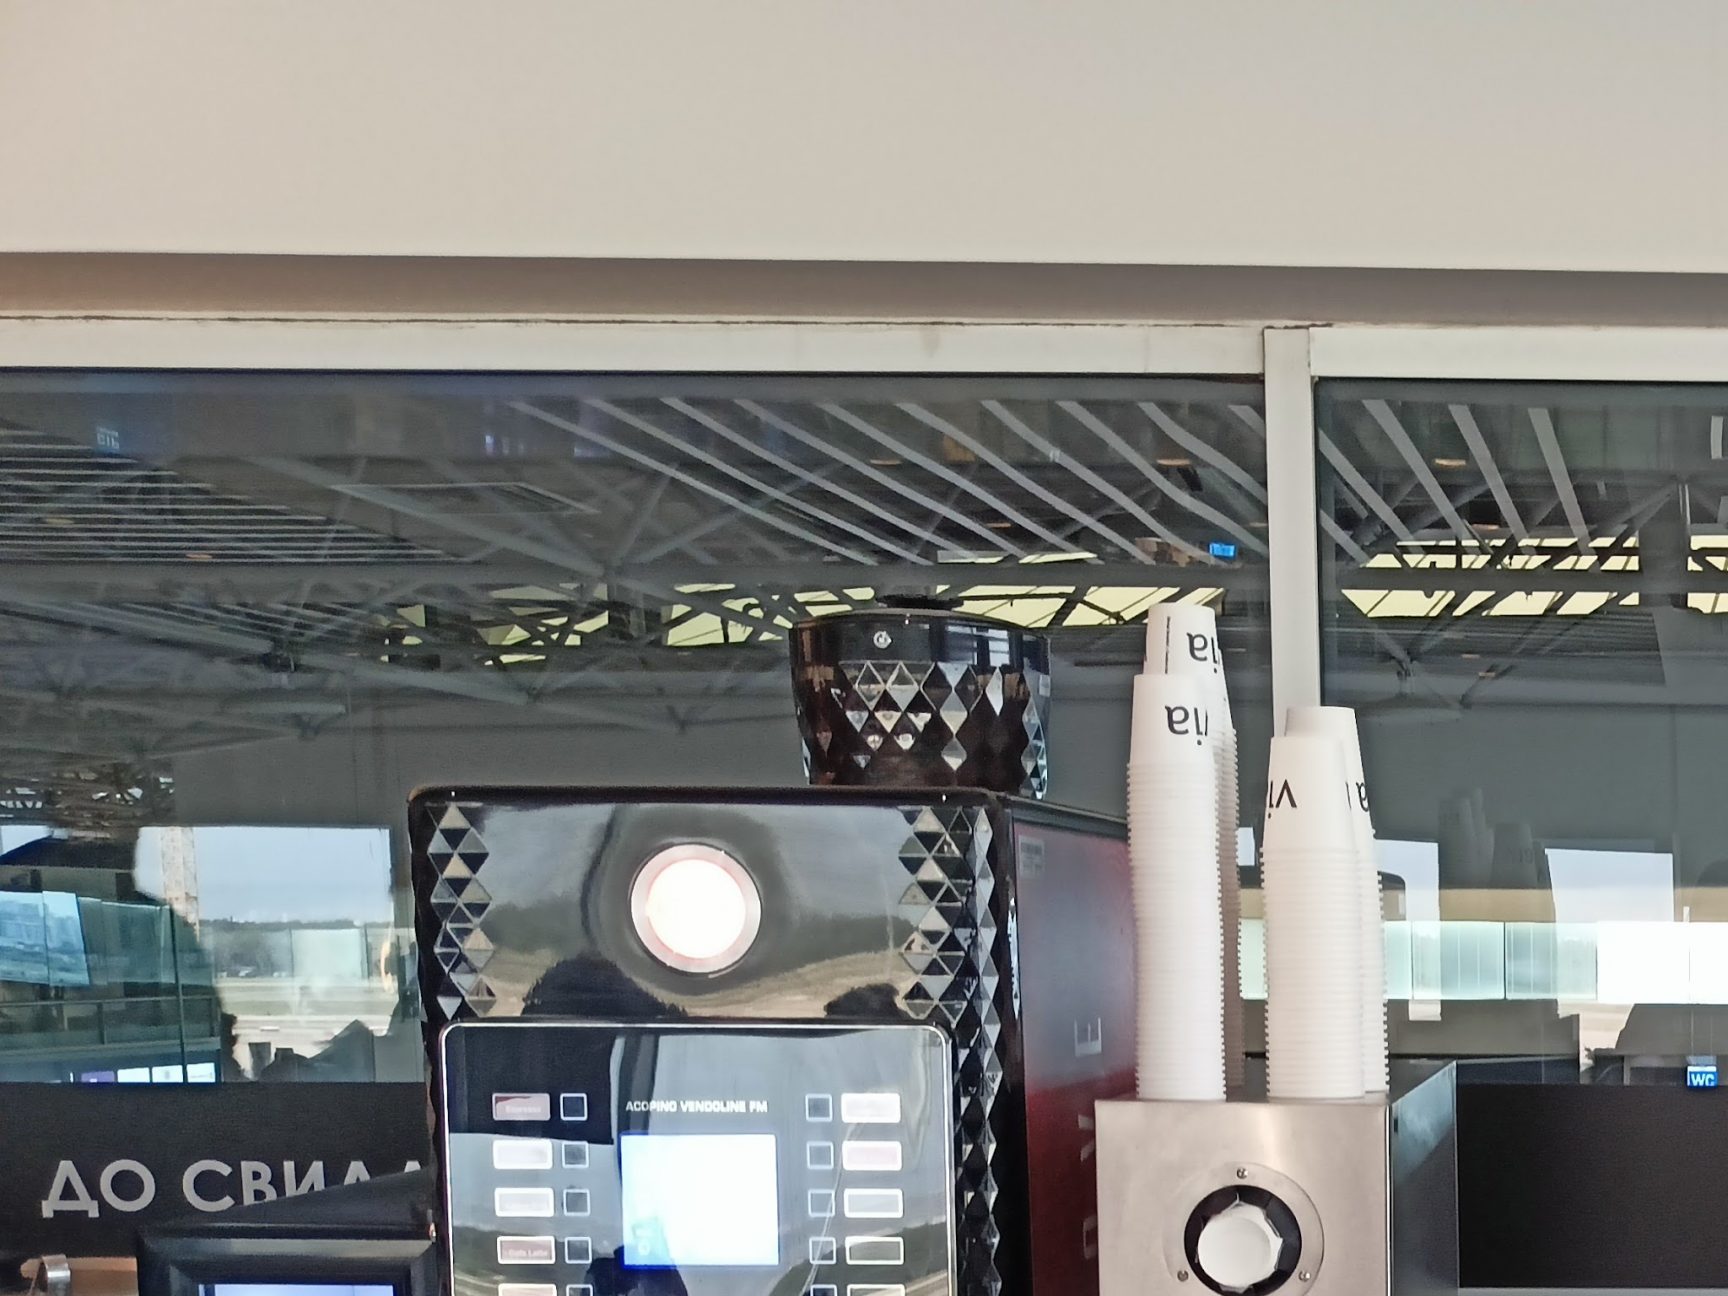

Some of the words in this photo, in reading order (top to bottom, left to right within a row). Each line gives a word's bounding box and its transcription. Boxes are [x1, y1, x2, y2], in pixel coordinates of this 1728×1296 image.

[1165, 704, 1209, 747] ia
[1690, 1072, 1715, 1087] WC
[41, 1158, 156, 1219] ДО
[182, 1158, 425, 1212] СВИ
